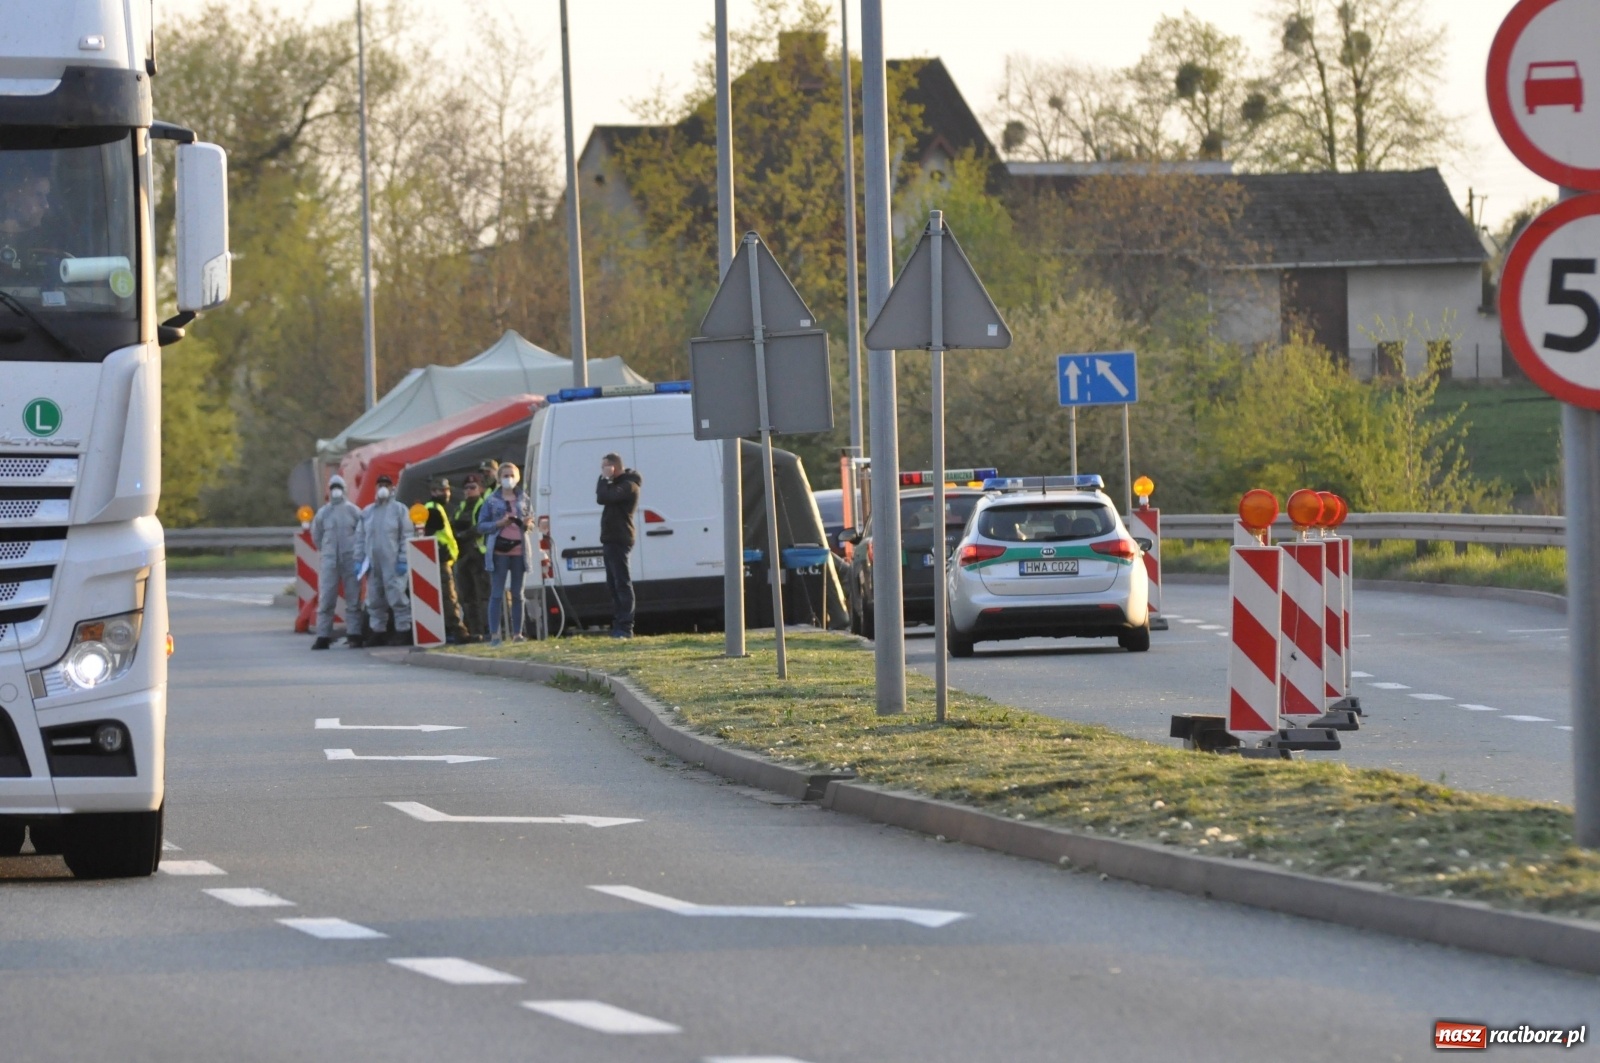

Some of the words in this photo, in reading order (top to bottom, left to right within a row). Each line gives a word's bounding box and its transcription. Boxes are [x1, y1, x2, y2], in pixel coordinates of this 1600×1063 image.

[1543, 258, 1600, 353] 5
[35, 404, 53, 431] L
[574, 558, 594, 568] HWA
[1026, 562, 1048, 572] HWA
[1051, 560, 1077, 572] C022
